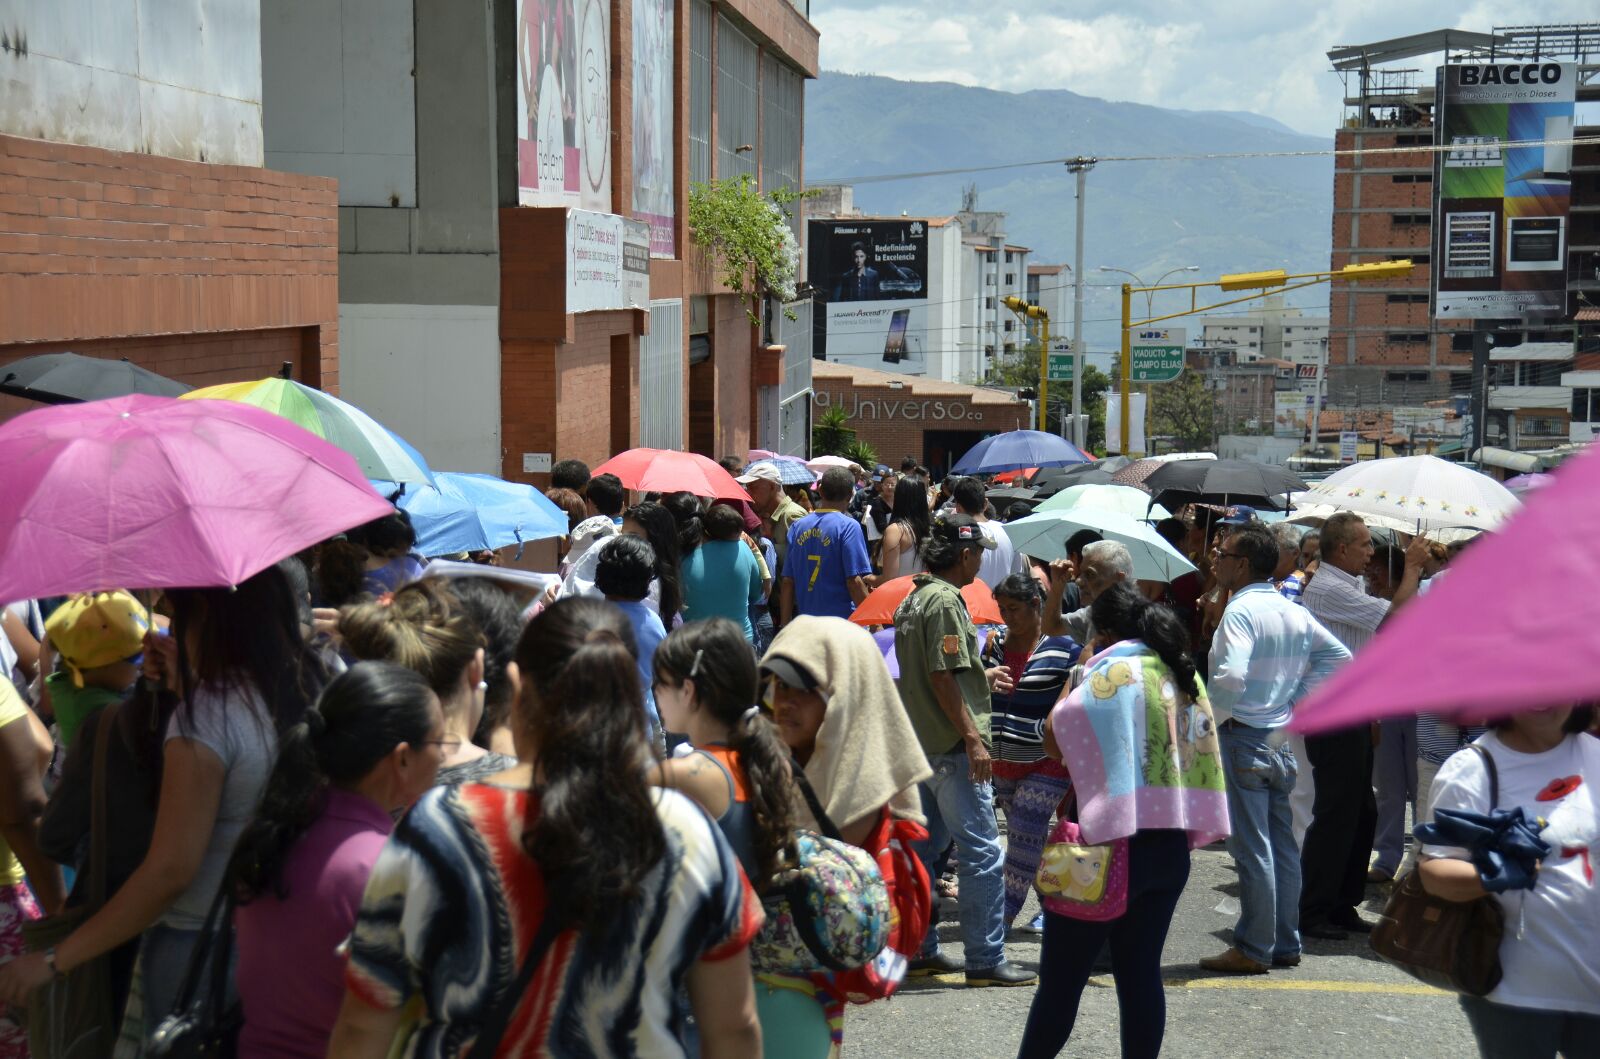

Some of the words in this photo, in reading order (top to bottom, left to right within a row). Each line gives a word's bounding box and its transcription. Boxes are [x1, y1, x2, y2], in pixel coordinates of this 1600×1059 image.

[1460, 63, 1561, 85] BACCO
[1514, 90, 1527, 98] los
[1529, 89, 1557, 98] Dioses
[875, 244, 916, 252] Redefiniendo
[875, 253, 881, 261] la
[883, 252, 915, 261] Excelencia
[857, 308, 881, 317] Ascend
[1134, 349, 1166, 358] VIADUCTO
[1133, 360, 1160, 369] CAMPO
[1161, 360, 1182, 369] ELIAS
[840, 393, 966, 420] Universo
[807, 554, 821, 592] 7
